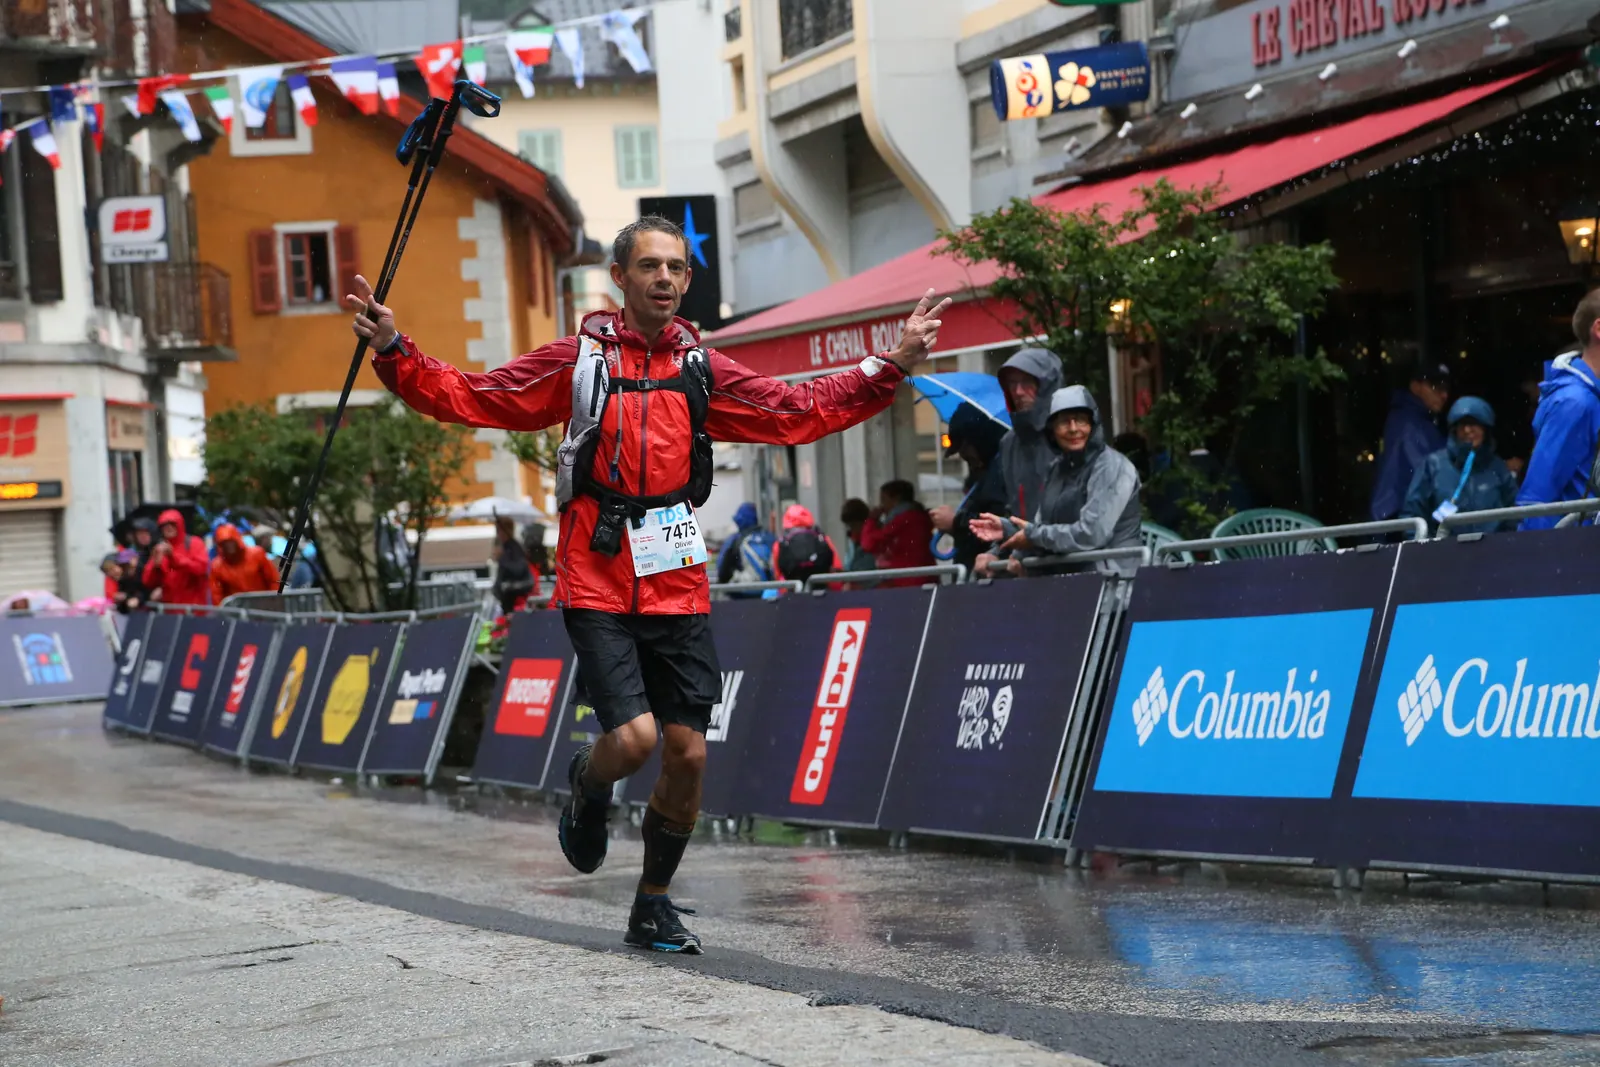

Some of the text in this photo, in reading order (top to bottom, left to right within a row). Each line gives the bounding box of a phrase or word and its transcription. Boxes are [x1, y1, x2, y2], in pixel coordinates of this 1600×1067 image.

[1250, 7, 1282, 66] LE
[1287, 0, 1385, 54] CHEVAL
[809, 334, 823, 366] LE
[825, 326, 868, 364] CHEVAL
[662, 521, 697, 543] 7475
[964, 663, 1026, 681] MOUNTAIN
[804, 624, 858, 792] OutDry
[957, 685, 990, 718] HARD
[1167, 666, 1331, 740] Columbia
[956, 717, 989, 750] WEAR
